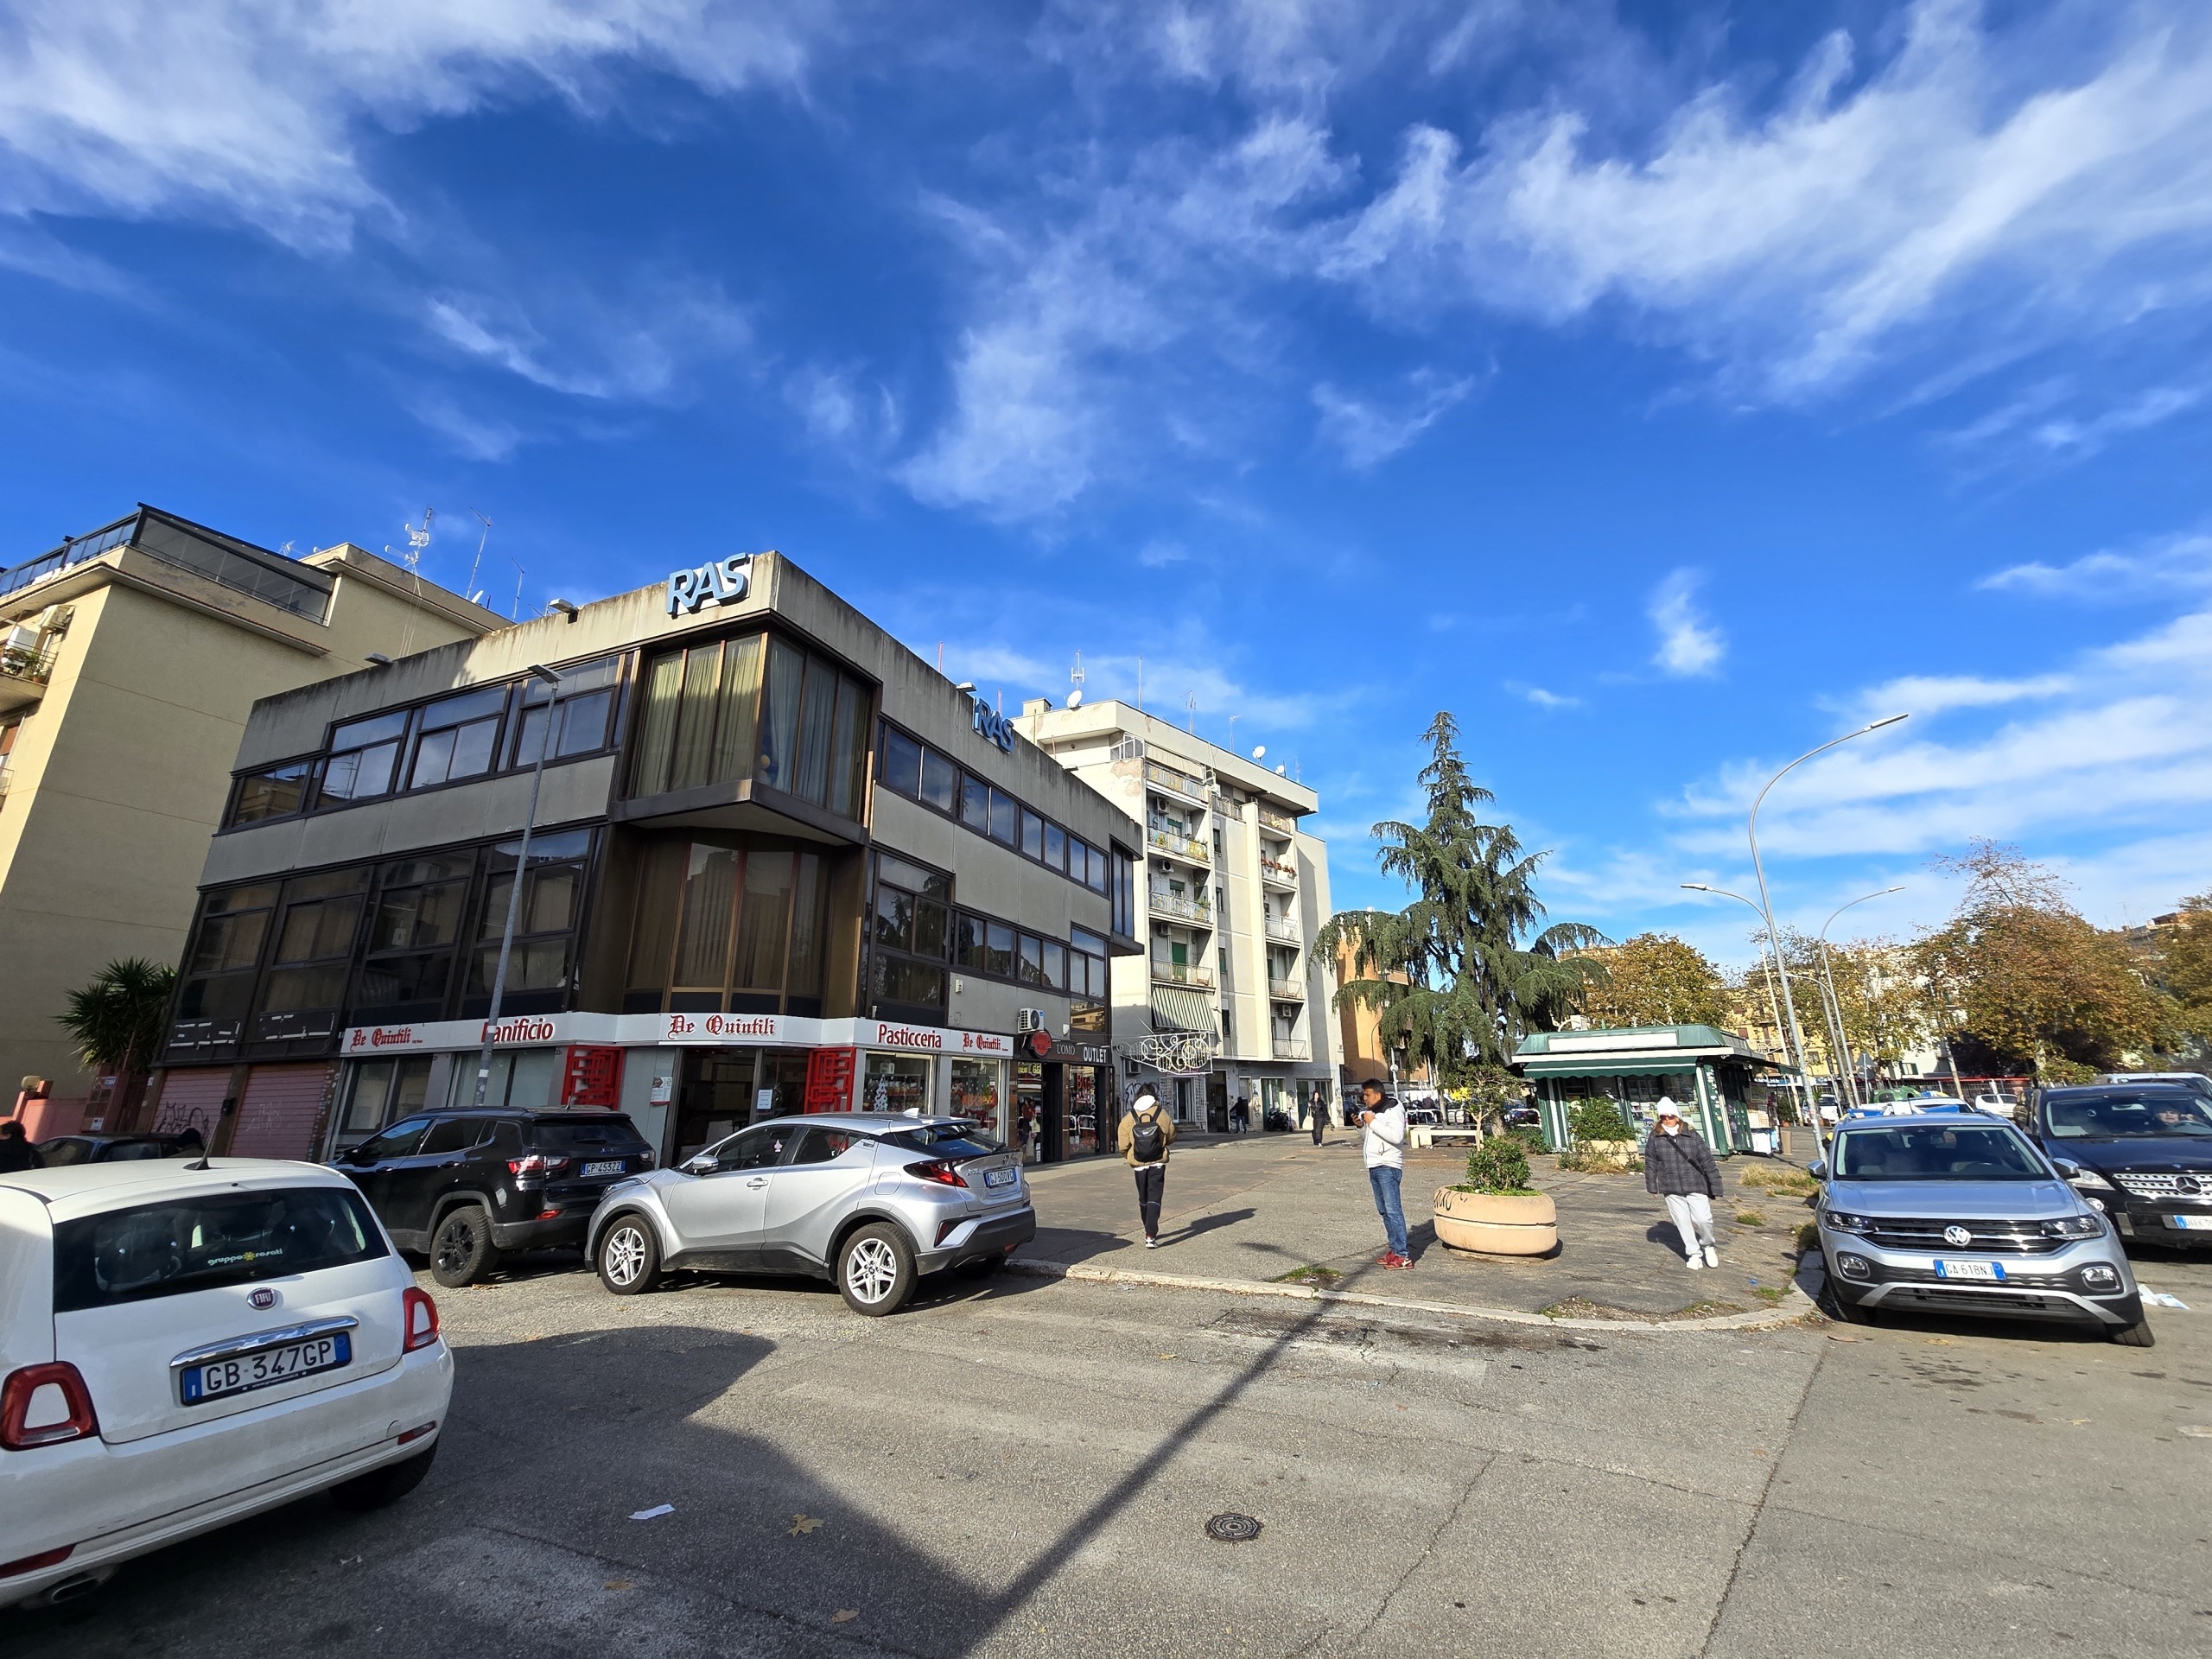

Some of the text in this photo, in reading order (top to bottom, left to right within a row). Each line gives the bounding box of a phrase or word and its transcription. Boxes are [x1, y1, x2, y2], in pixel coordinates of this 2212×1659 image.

[666, 552, 751, 615] RAS
[973, 696, 1014, 753] RAS
[667, 1014, 775, 1039] De Quintili
[878, 1023, 942, 1048] Pasticceria
[350, 1027, 412, 1052] De Quintili
[962, 1033, 1001, 1052] De Quintili
[1057, 1044, 1076, 1055] UOMO
[1083, 1046, 1107, 1064] OUTLET
[207, 1249, 283, 1266] gruppo rosati
[254, 1292, 272, 1304] FIAT
[207, 1362, 240, 1391] GB
[251, 1340, 332, 1380] 347GP
